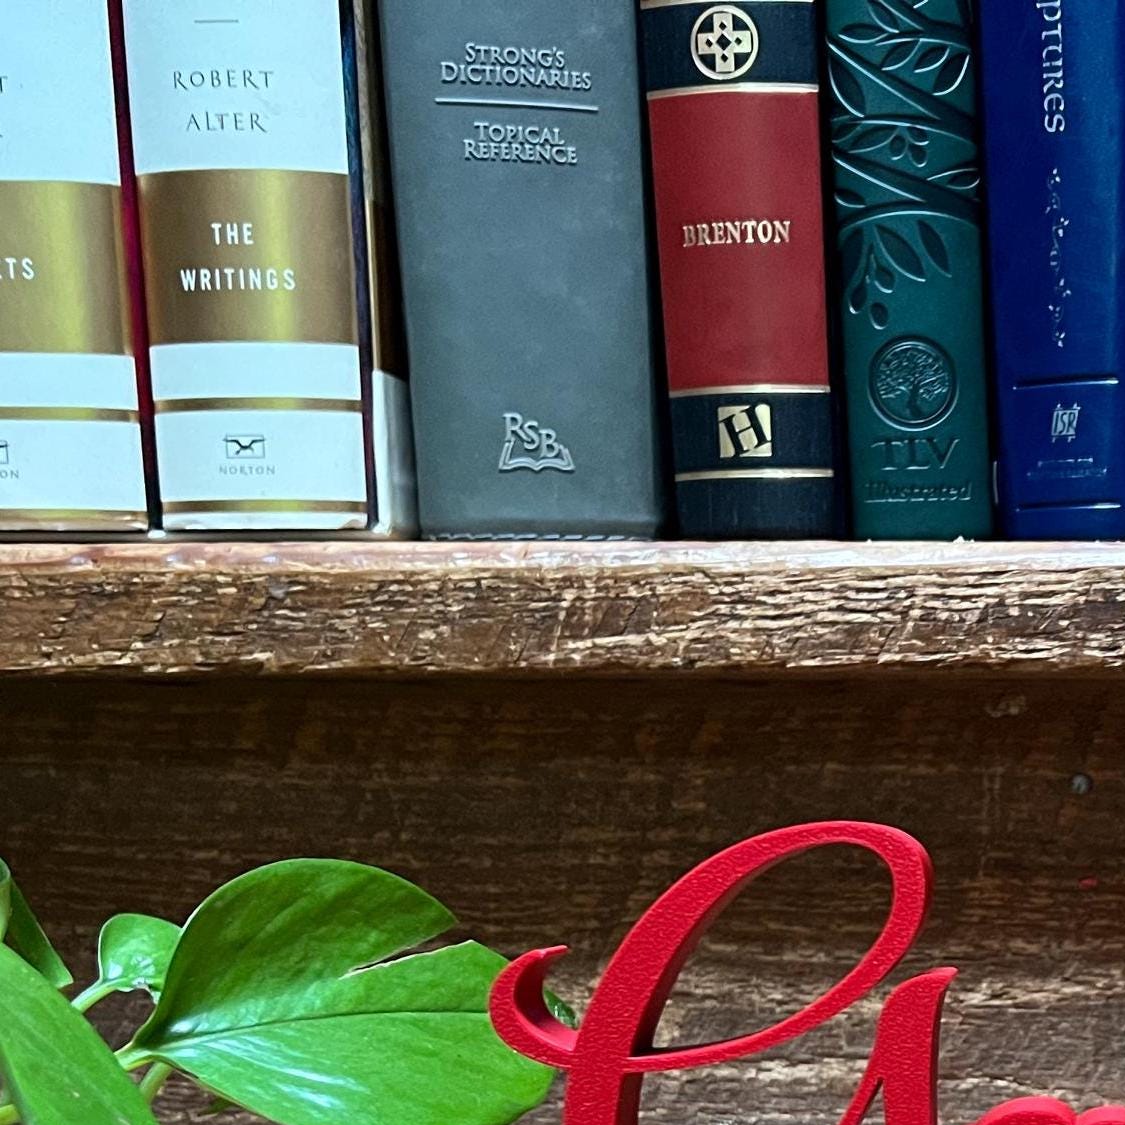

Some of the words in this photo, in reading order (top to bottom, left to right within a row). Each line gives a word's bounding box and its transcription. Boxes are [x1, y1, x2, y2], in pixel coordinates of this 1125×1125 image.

[465, 42, 565, 69] STRONG'S
[173, 69, 275, 91] ROBERT
[440, 62, 592, 91] DICTIONARIES
[186, 111, 267, 133] ALTER
[473, 121, 565, 146] TOPICAL
[463, 139, 578, 165] REFERENCE
[211, 222, 254, 245] THE
[682, 219, 791, 248] BRENTON
[0, 257, 34, 280] TS
[180, 268, 297, 291] WRITINGS
[503, 412, 560, 458] RSB
[218, 465, 275, 476] NORTON
